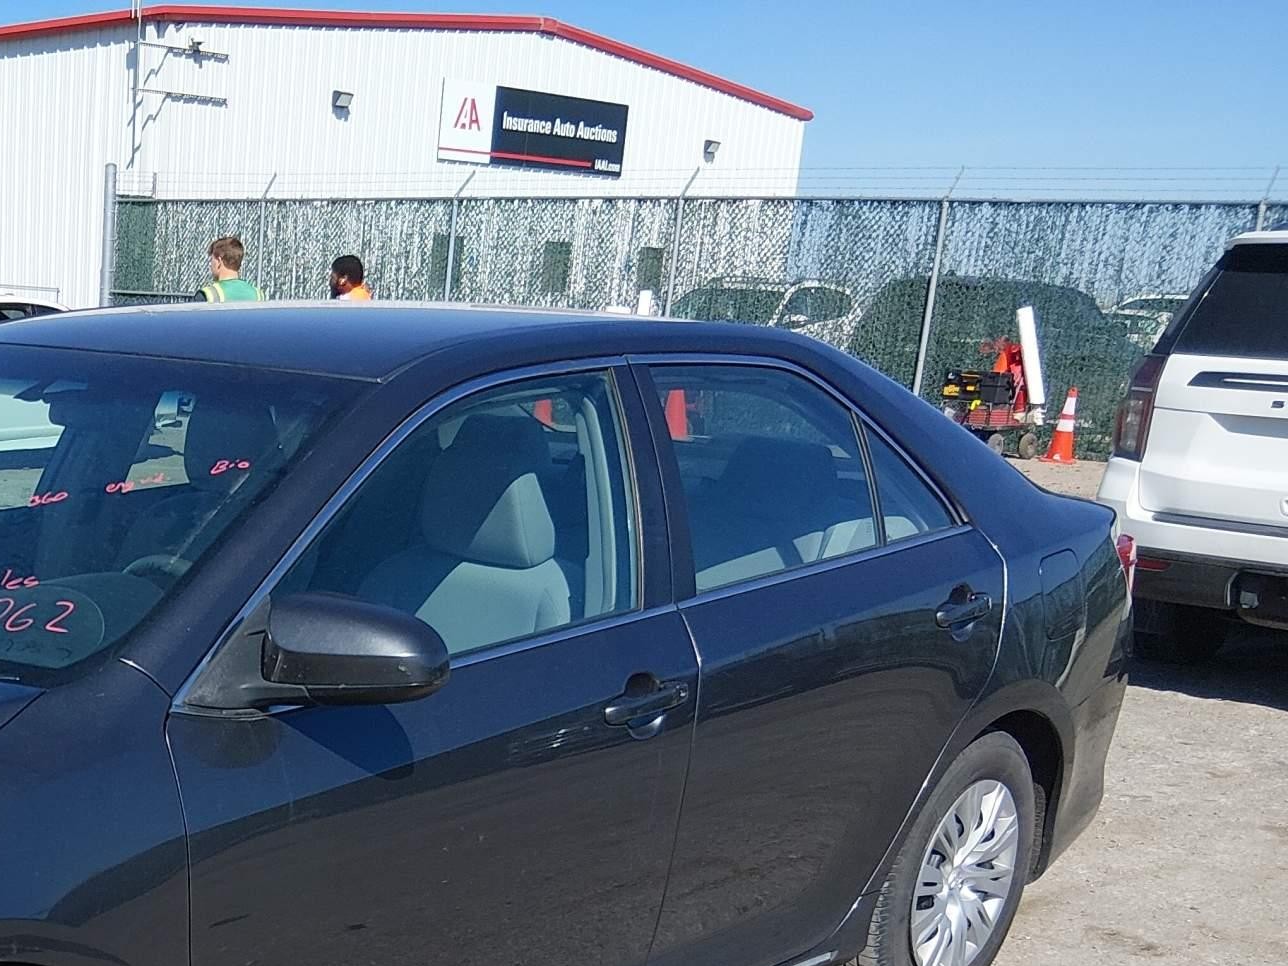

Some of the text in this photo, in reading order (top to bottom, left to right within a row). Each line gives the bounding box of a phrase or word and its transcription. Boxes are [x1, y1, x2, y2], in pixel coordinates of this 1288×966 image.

[502, 110, 617, 143] Insurance Auto Auctions
